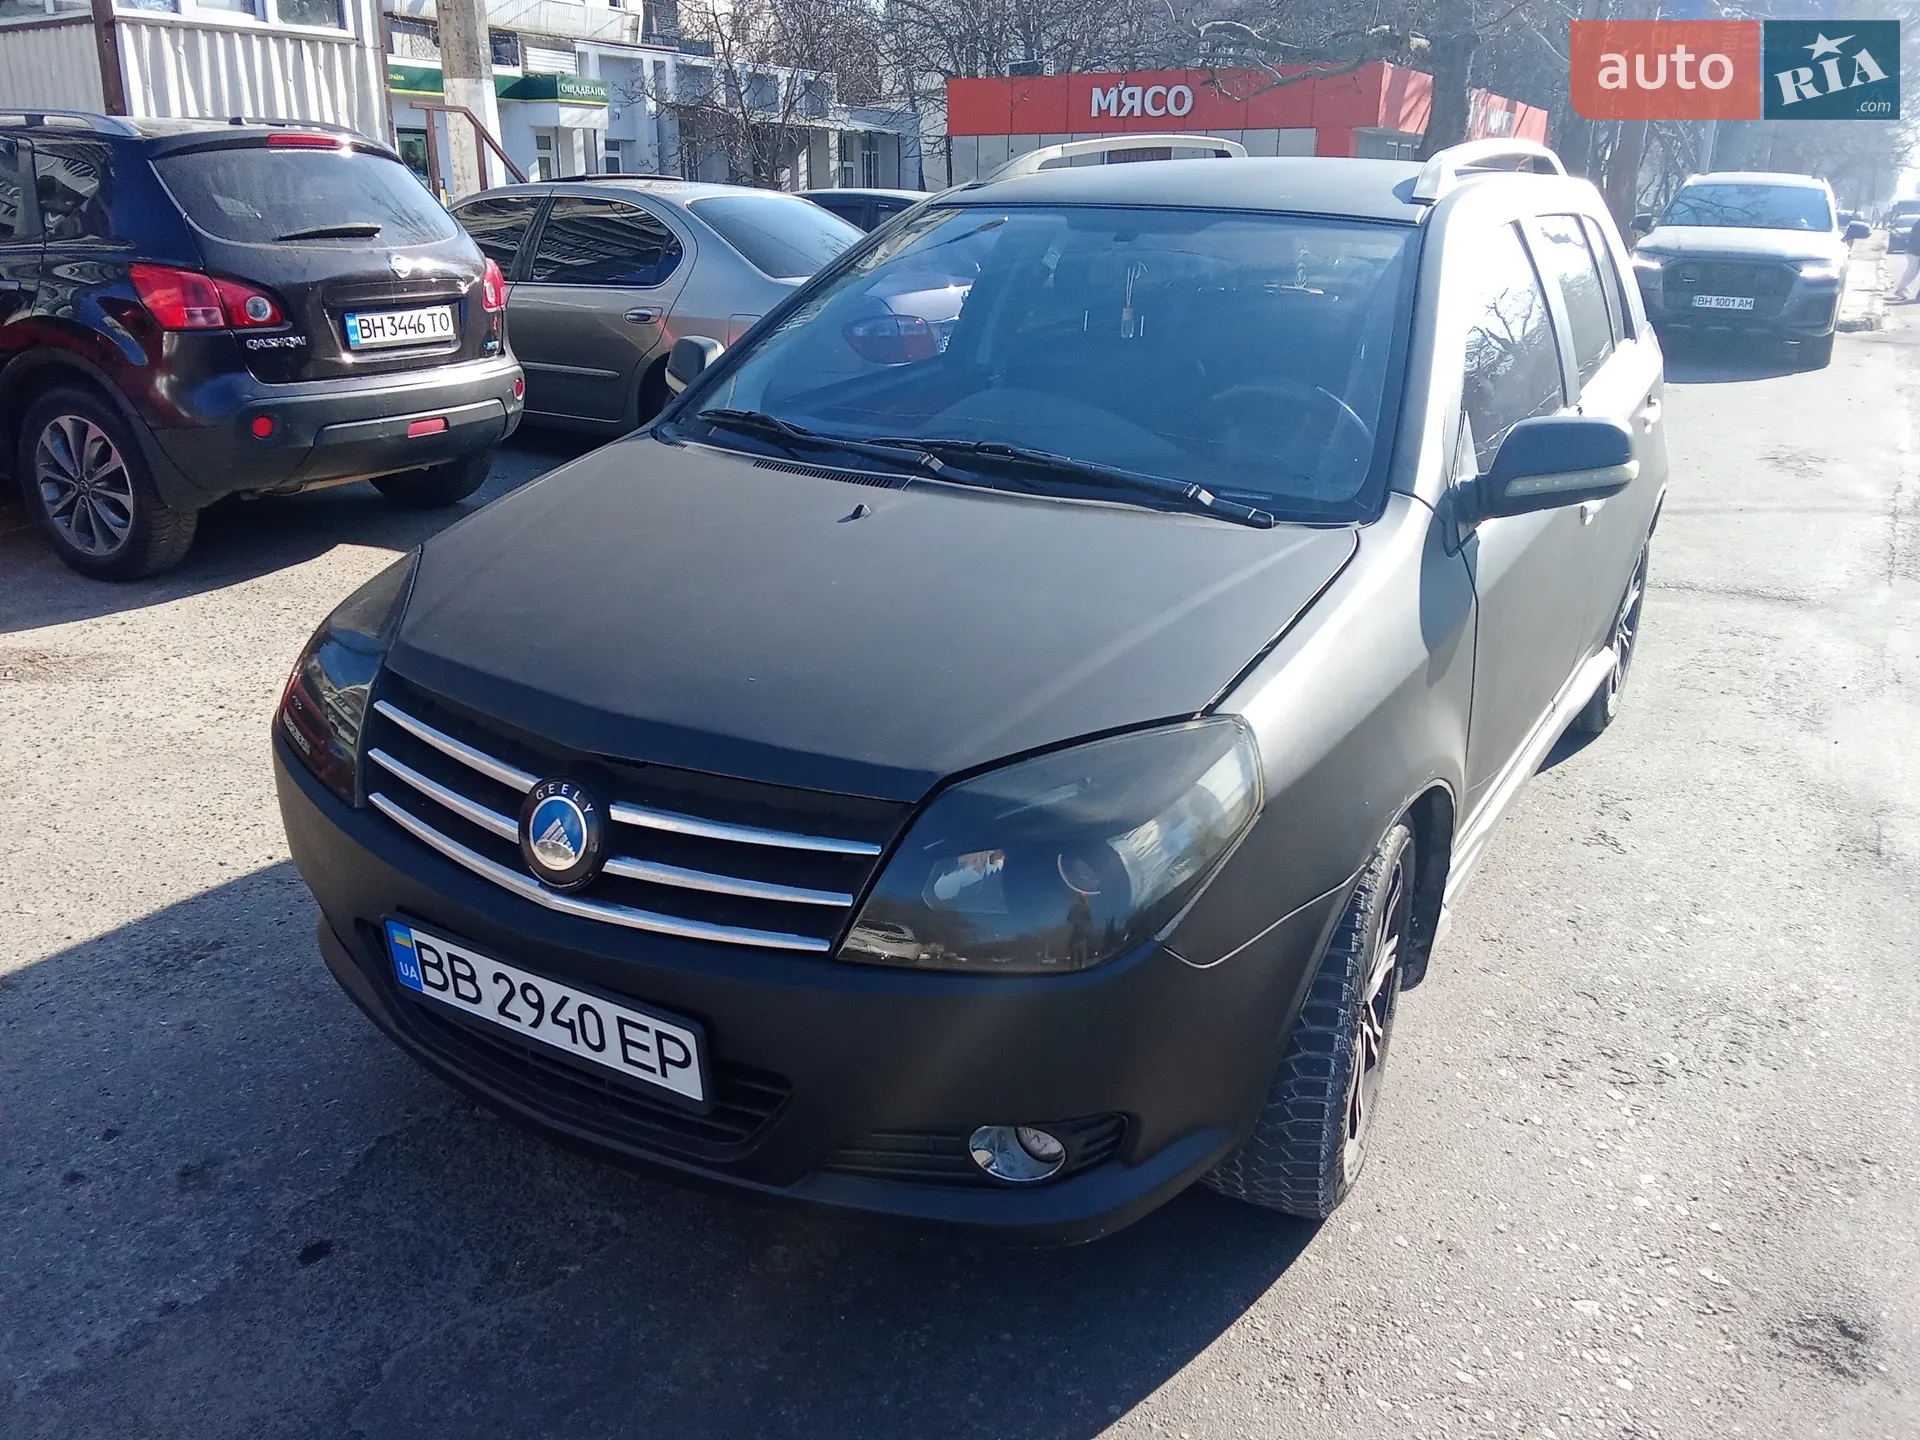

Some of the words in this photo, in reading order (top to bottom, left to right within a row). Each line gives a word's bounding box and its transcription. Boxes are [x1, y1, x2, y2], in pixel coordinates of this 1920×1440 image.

[560, 83, 606, 98] ОЩАДБАНК
[1091, 80, 1193, 117] М'ЯСО
[1697, 296, 1713, 306] BH
[1714, 297, 1736, 307] 1001
[1737, 299, 1753, 308] AM
[358, 317, 386, 339] BH
[387, 313, 426, 336] 3446
[427, 312, 450, 333] TO
[246, 335, 307, 350] QASHQAI
[536, 783, 594, 813] GEELY
[399, 960, 419, 981] UA
[414, 939, 483, 1004] BB
[493, 970, 606, 1053] 2940
[616, 1015, 692, 1079] EP
